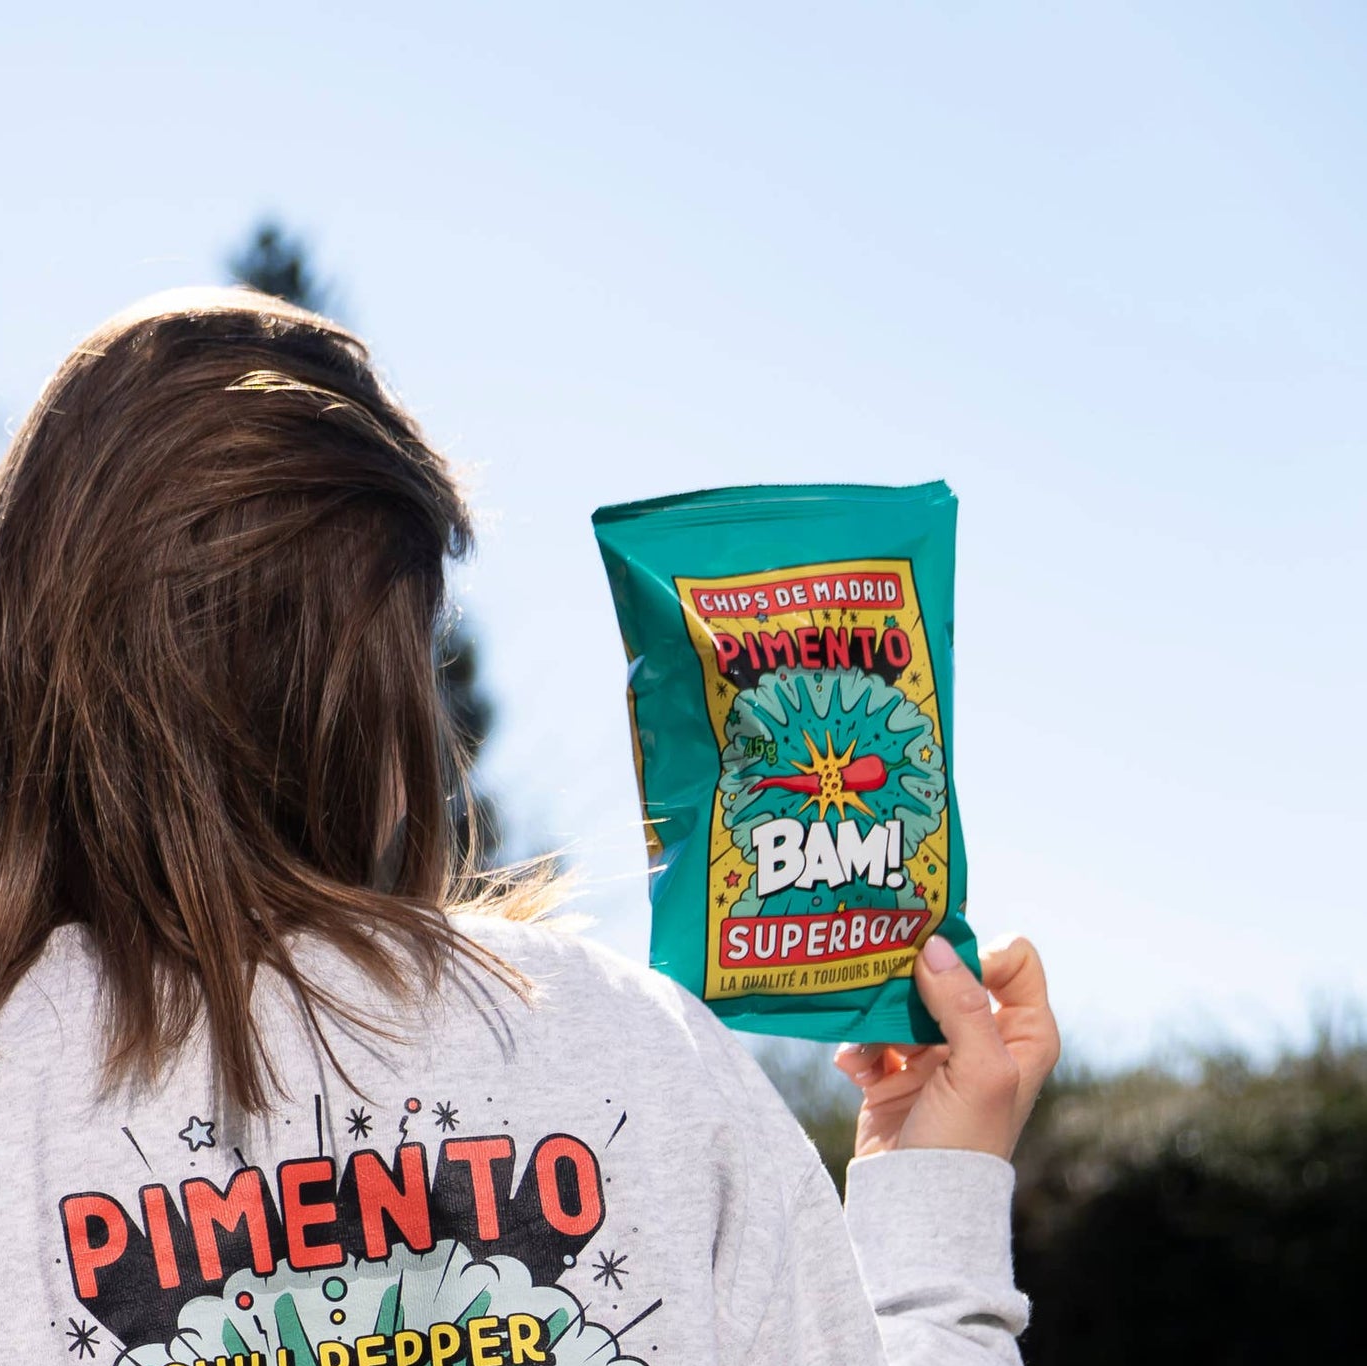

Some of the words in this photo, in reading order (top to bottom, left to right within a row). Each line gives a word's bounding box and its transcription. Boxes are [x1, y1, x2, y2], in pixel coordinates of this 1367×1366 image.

[699, 590, 769, 612] CHIPS
[777, 584, 808, 608] DE
[813, 578, 898, 604] MADRID
[712, 625, 913, 675] PIMENTO
[743, 735, 778, 765] 45g
[750, 818, 907, 898] BAM!
[726, 913, 922, 962] SUPERBON
[720, 976, 737, 992] LA
[800, 972, 809, 987] A
[813, 963, 870, 987] TOUJOURS
[59, 1132, 606, 1300] PIMENTO
